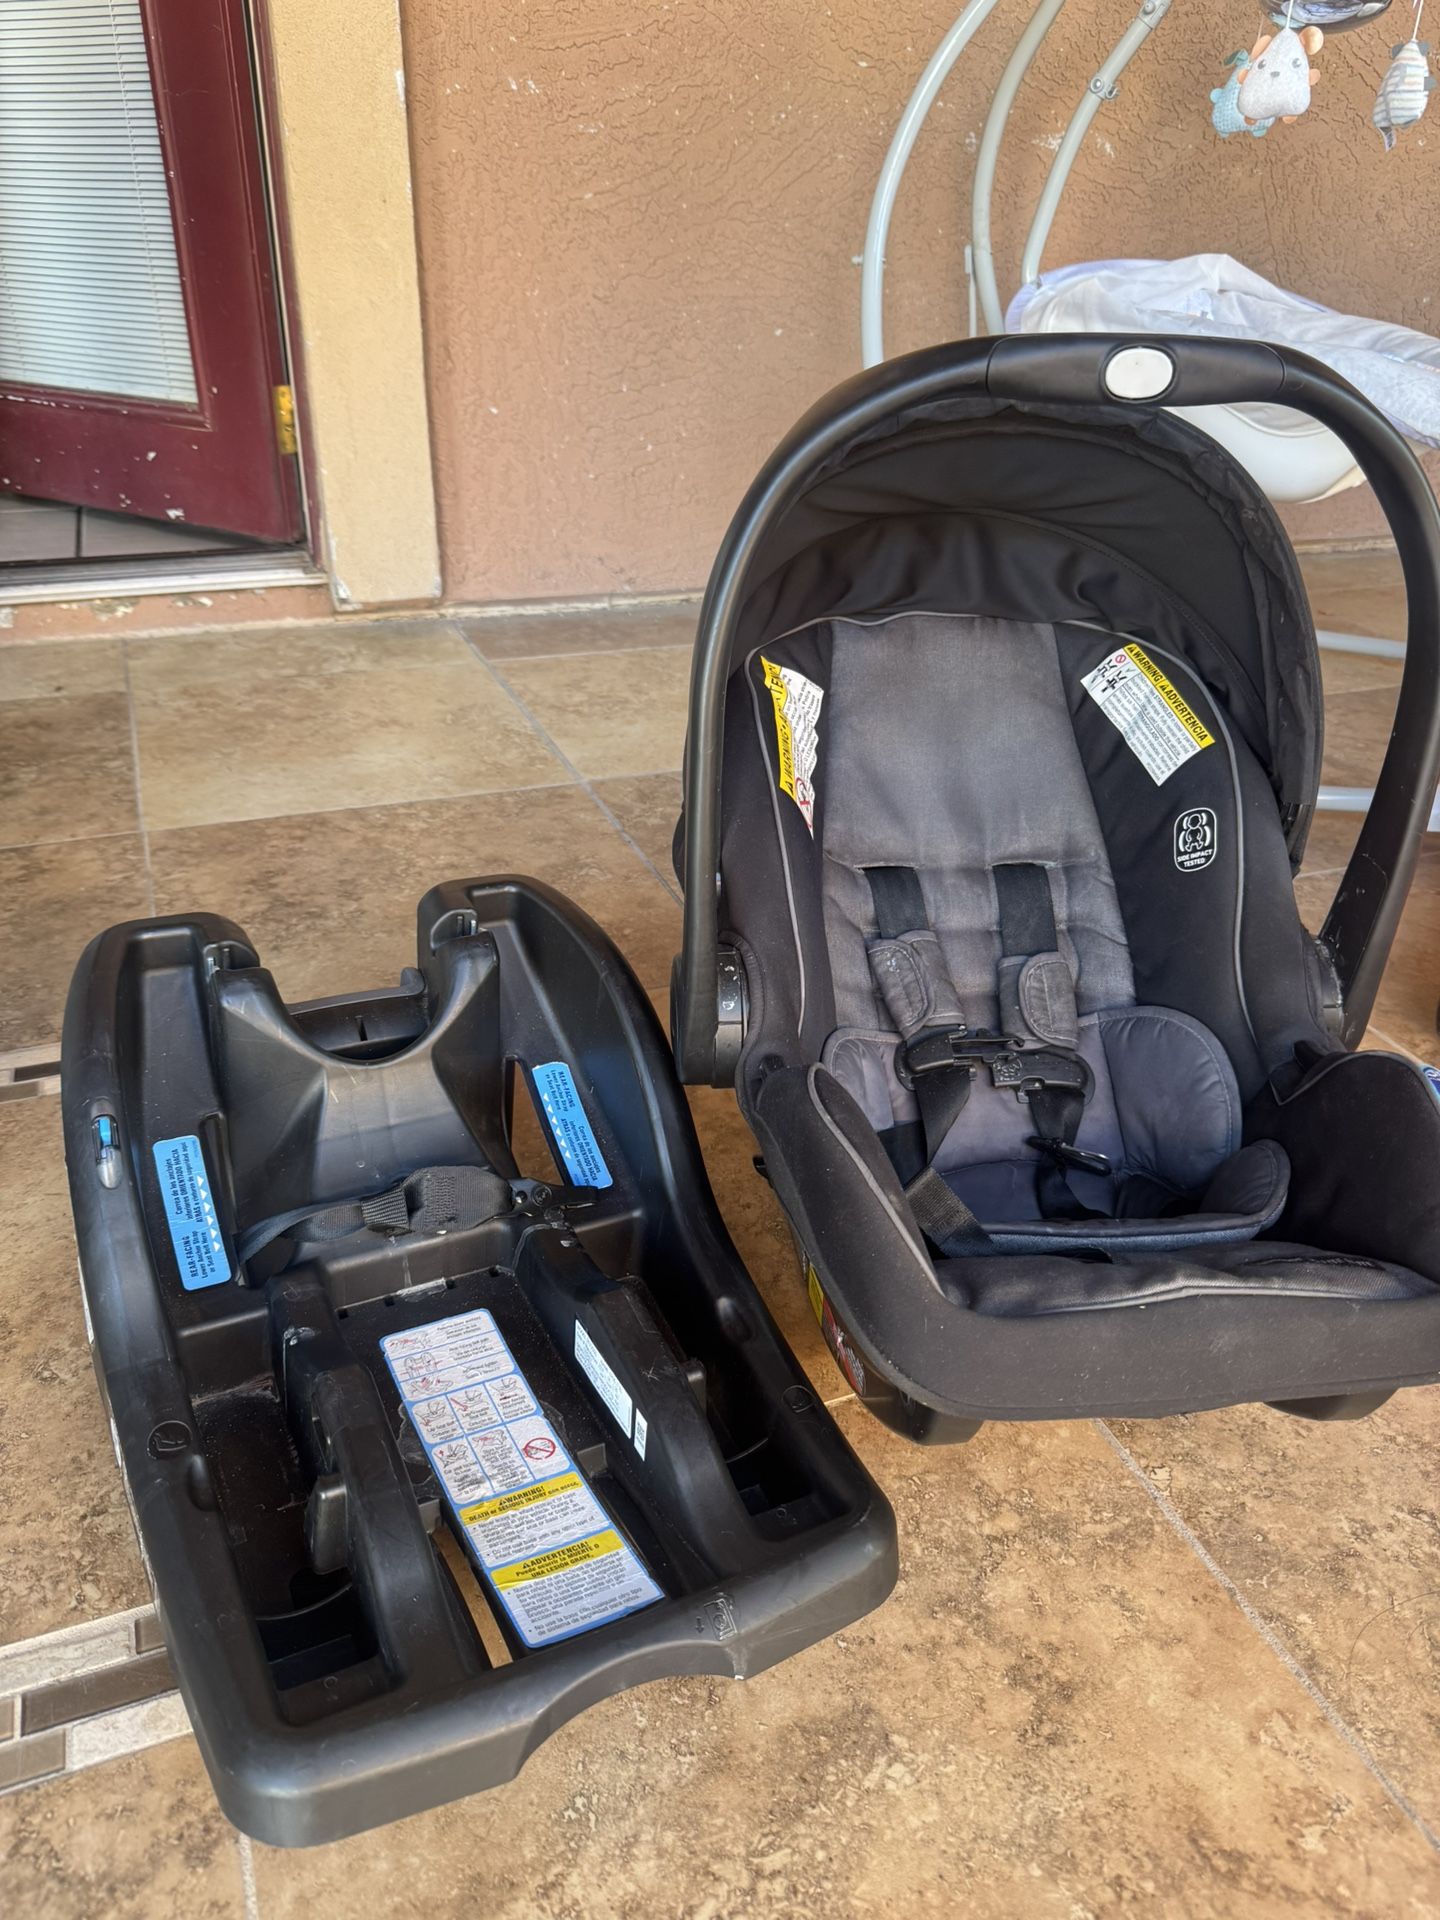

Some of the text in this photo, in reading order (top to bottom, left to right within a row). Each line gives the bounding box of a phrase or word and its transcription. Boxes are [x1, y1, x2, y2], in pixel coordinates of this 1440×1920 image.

[1131, 649, 1163, 683] WARNING
[1162, 687, 1209, 741] ADVERTENCIA
[1176, 847, 1212, 862] SIDE IMPACT
[1183, 856, 1205, 868] TESTED
[181, 1234, 199, 1278] REAR-FACING
[504, 1484, 546, 1503] WARNING!
[529, 1539, 590, 1567] ADVERTENCIA!
[530, 1568, 547, 1579] UNA
